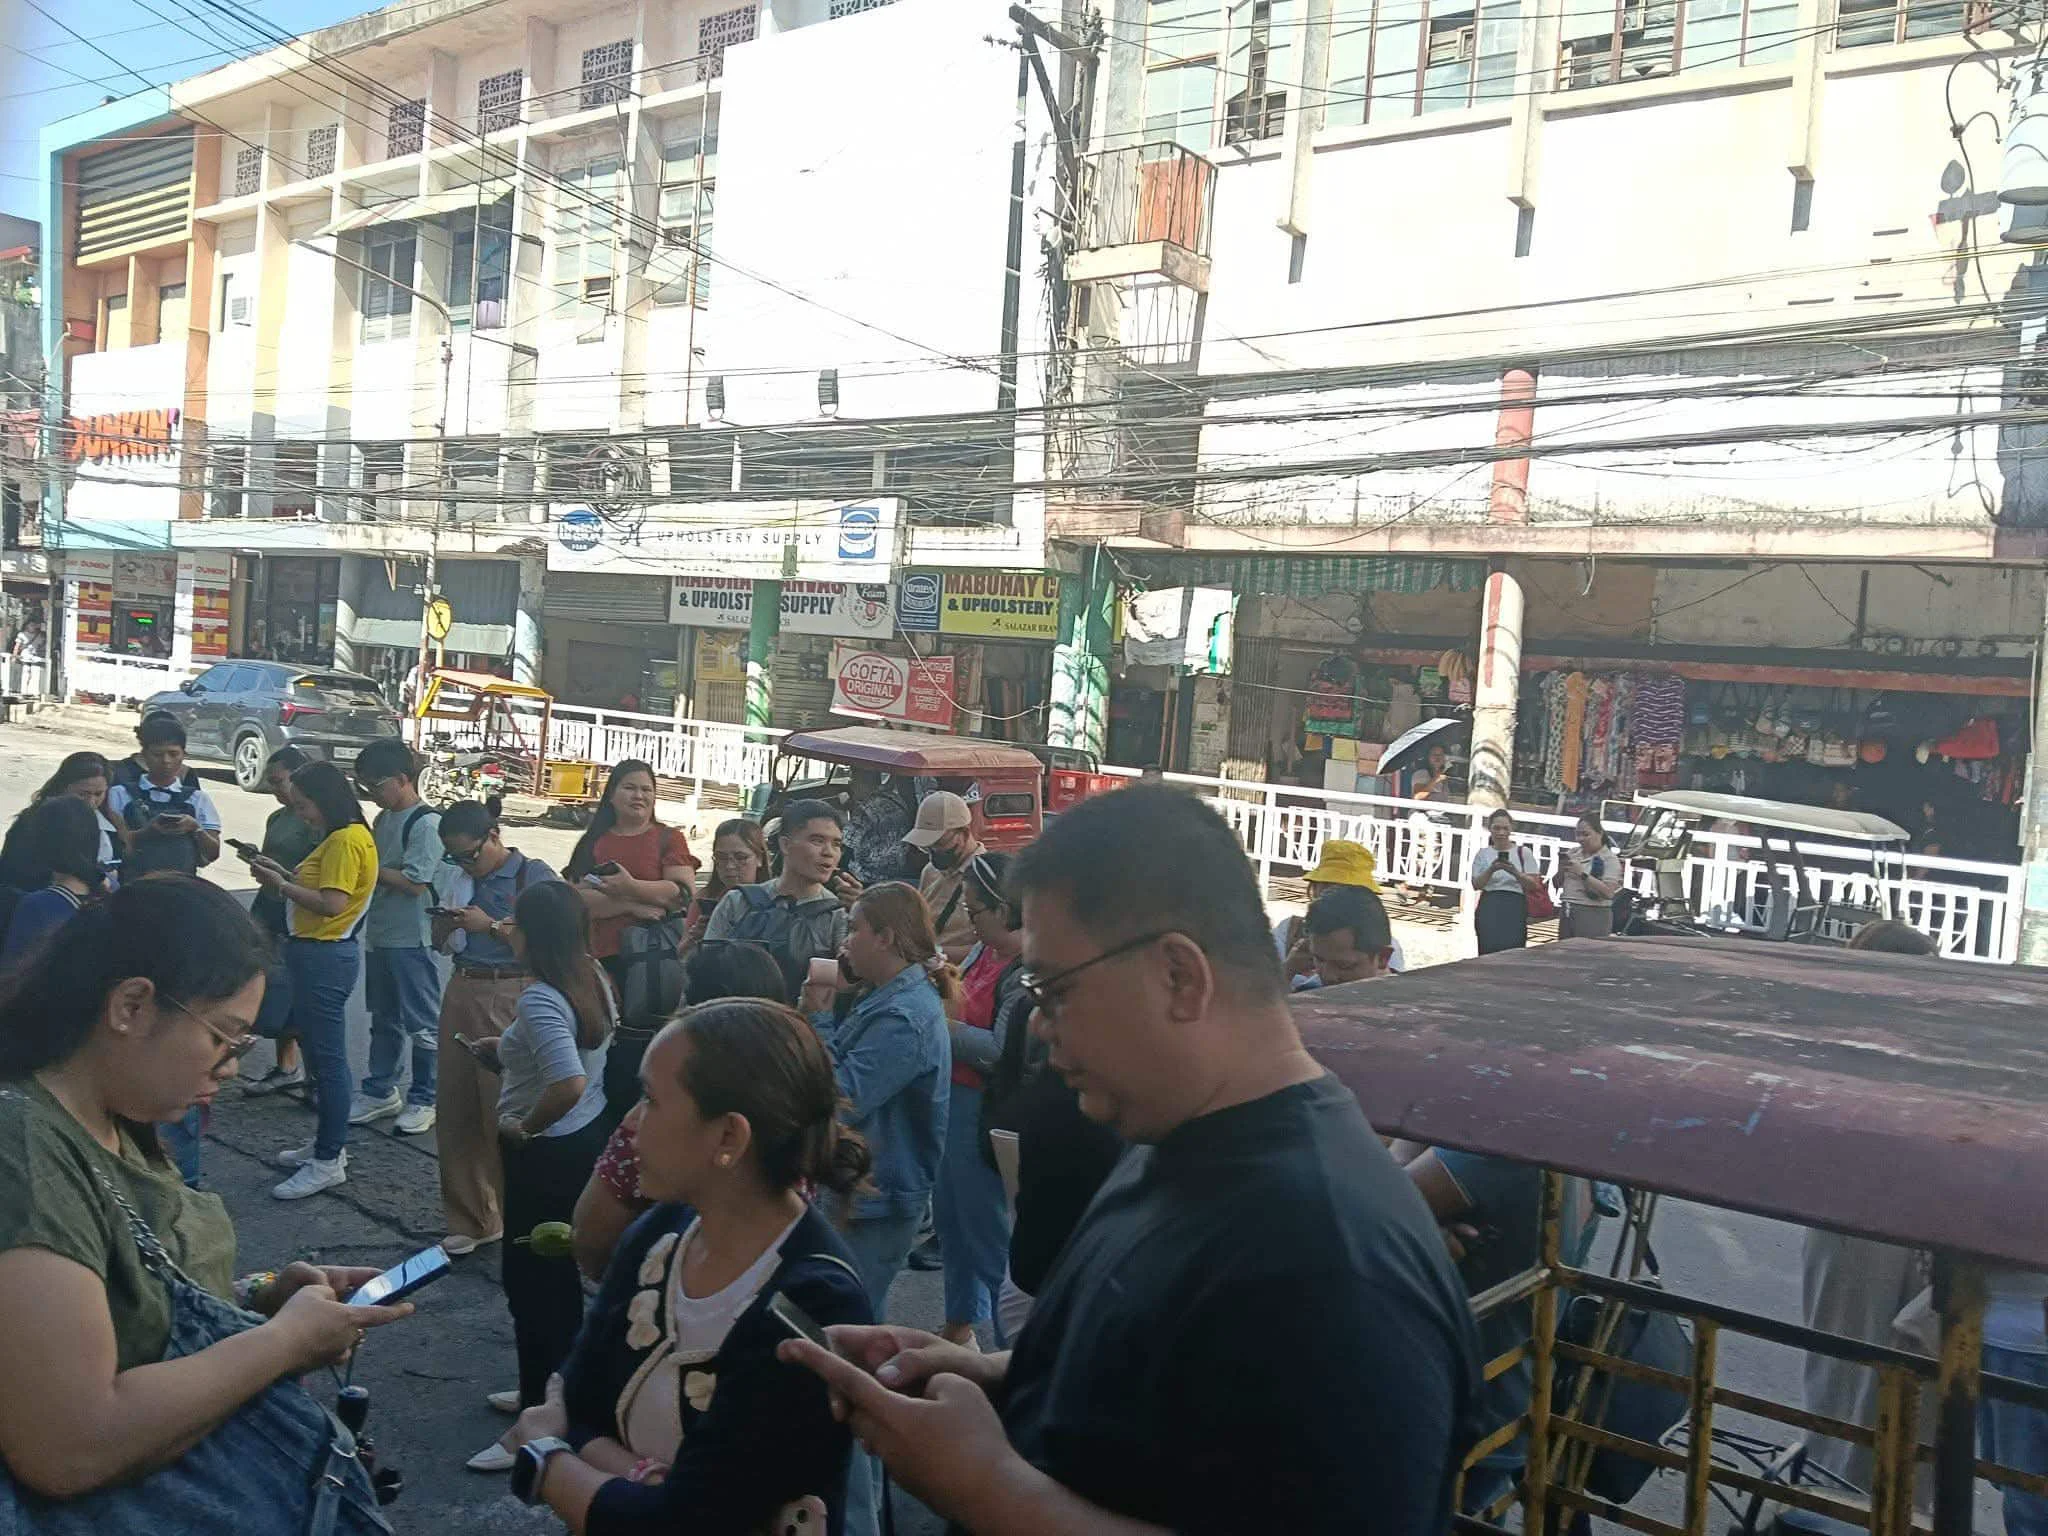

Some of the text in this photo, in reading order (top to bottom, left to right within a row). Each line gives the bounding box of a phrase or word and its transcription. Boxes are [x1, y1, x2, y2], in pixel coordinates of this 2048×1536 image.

[657, 530, 824, 545] UPHOLSTERY SUPPLY
[945, 574, 1039, 598] MABUHAY
[679, 591, 690, 607] &
[780, 595, 834, 615] SUPPLY
[948, 598, 959, 612] &
[962, 597, 1053, 616] UPHOLSTERY
[849, 662, 895, 684] COFTA
[847, 679, 895, 699] ORIGINAL
